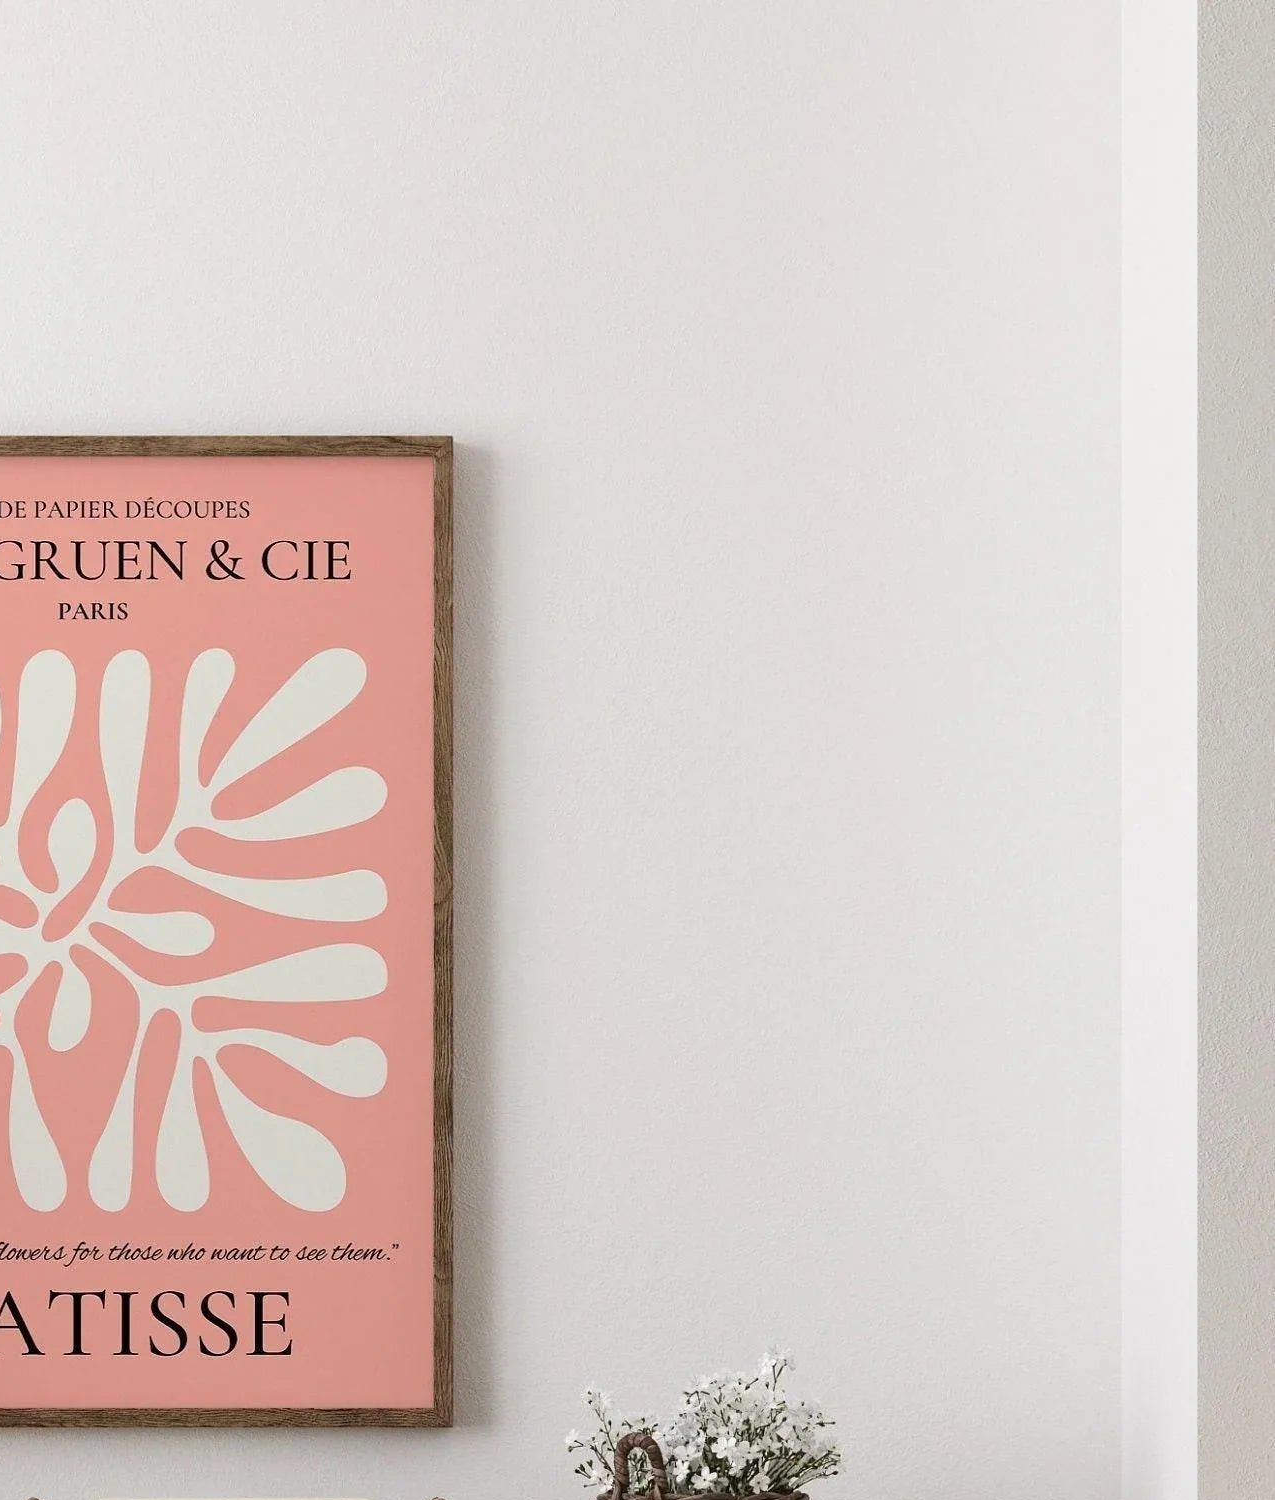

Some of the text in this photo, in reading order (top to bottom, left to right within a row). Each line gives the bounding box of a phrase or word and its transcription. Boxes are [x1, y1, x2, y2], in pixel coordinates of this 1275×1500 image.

[34, 500, 119, 519] PAPIER
[125, 496, 251, 519] DÉCOUPES
[205, 539, 246, 581] &
[261, 540, 352, 581] CIE
[57, 602, 128, 620] PARIS
[63, 1241, 105, 1267] for
[108, 1242, 164, 1261] those
[167, 1242, 207, 1261] who
[210, 1245, 268, 1261] want
[269, 1244, 292, 1261] to
[294, 1245, 329, 1261] see
